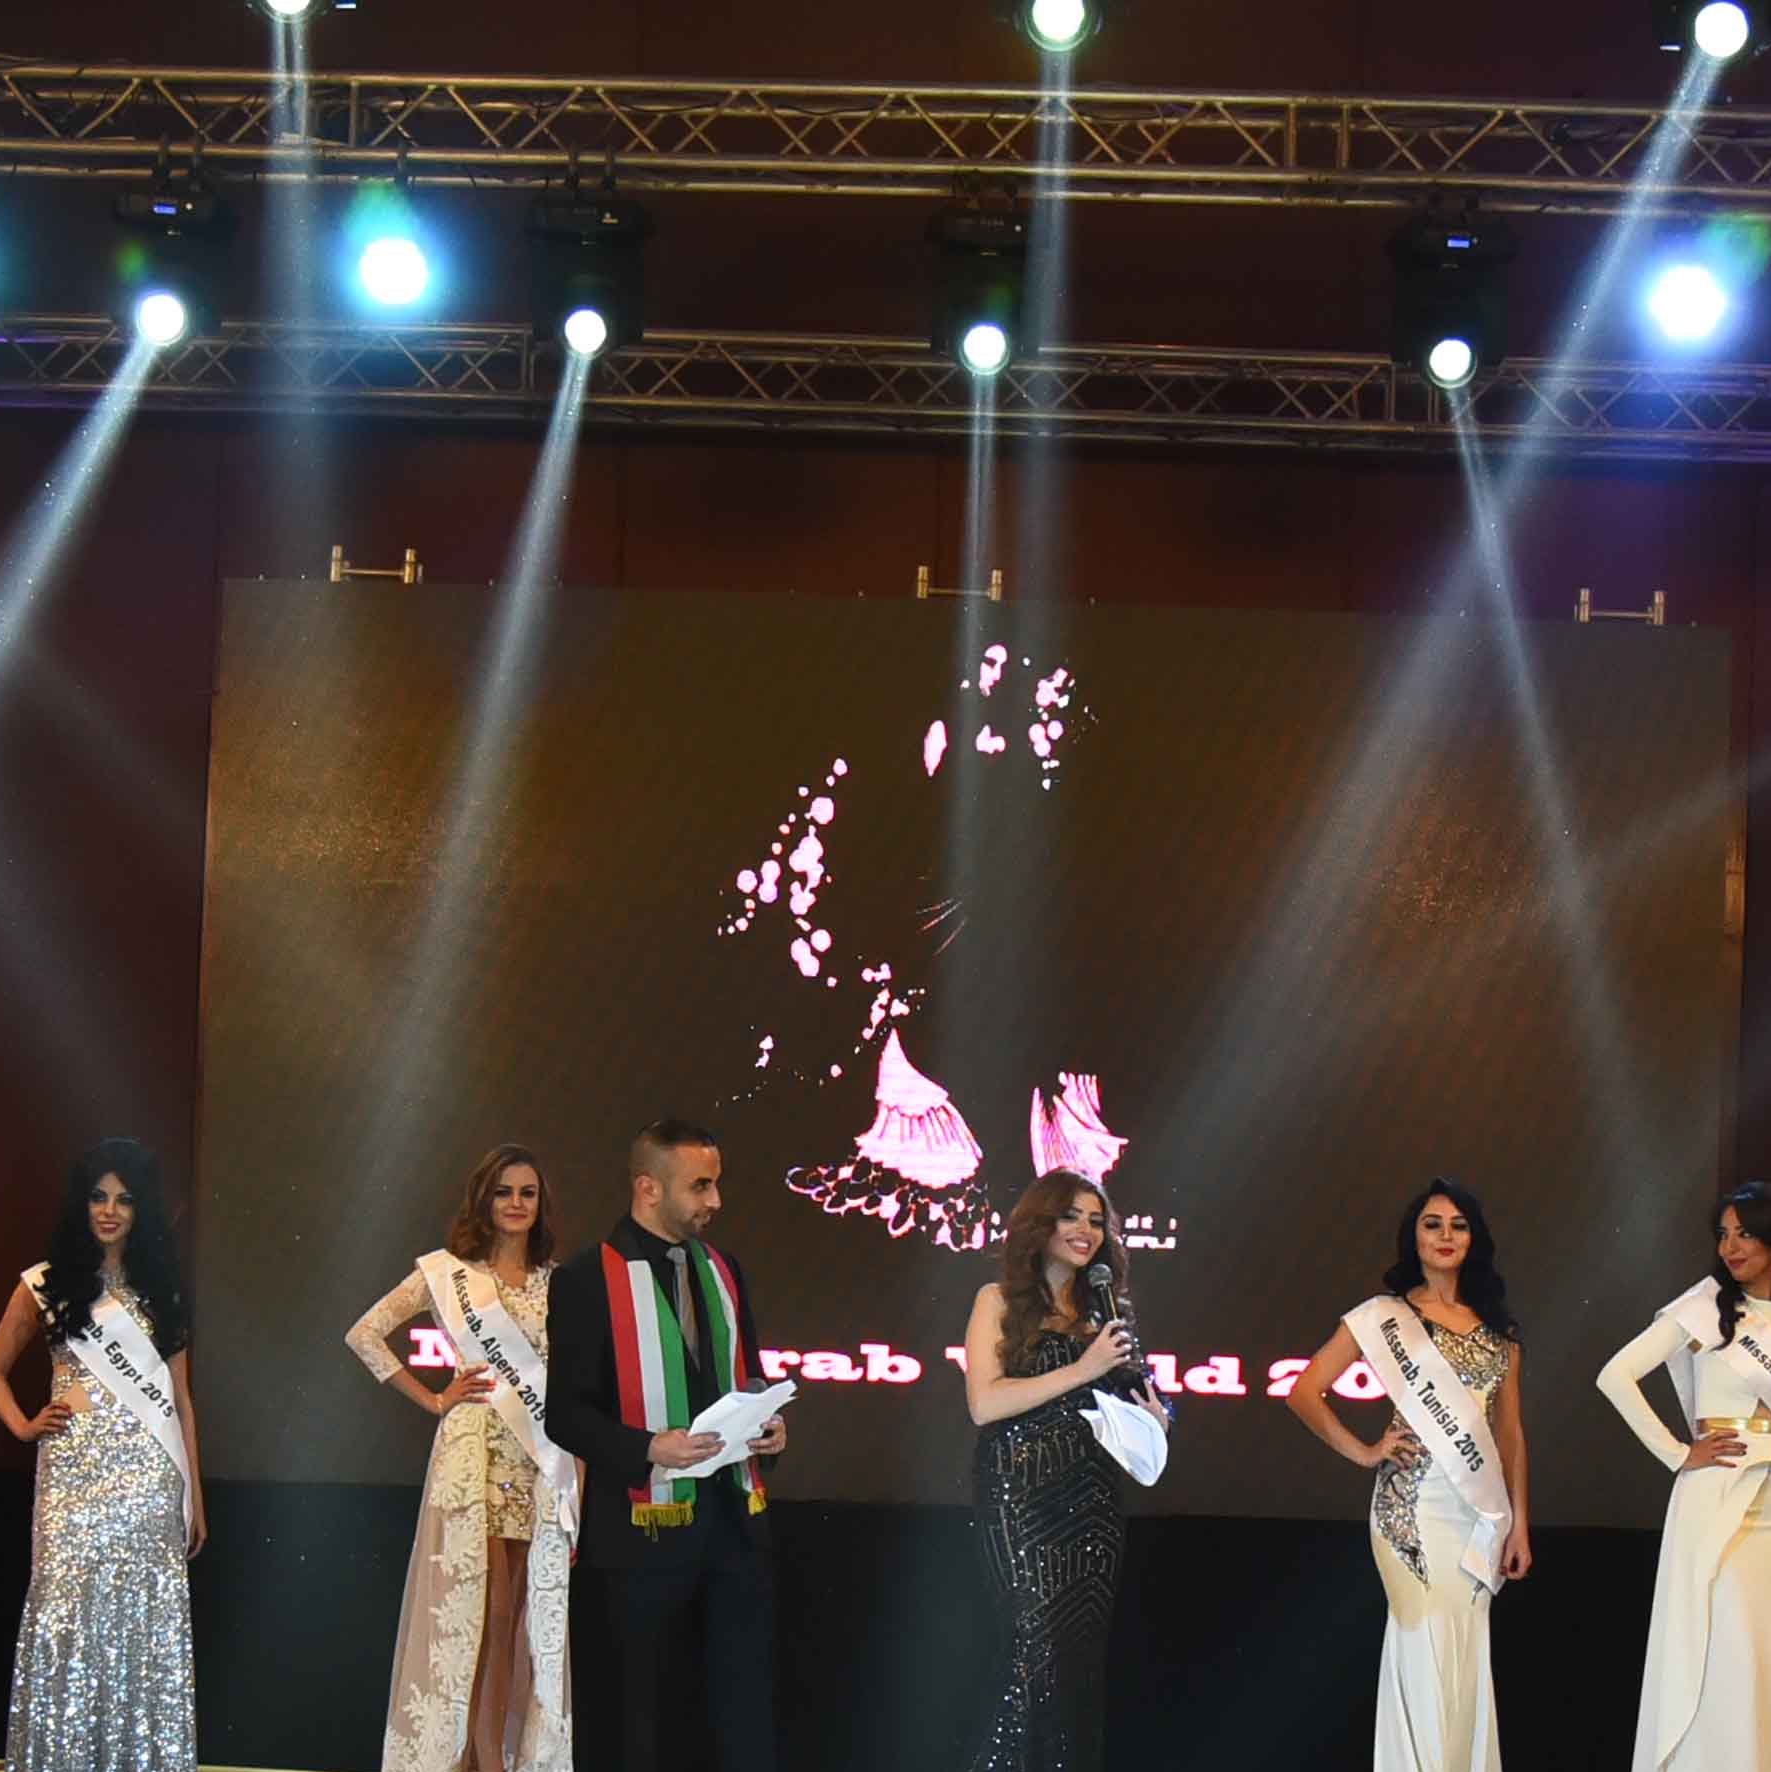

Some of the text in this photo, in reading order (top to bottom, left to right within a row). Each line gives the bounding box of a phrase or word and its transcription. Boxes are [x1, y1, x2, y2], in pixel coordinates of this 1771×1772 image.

[104, 1340, 174, 1418] Egypt 2015
[451, 1268, 546, 1423] Missarab. Algeria 2015
[756, 1343, 922, 1383] rab
[1380, 1317, 1485, 1473] Missarab. Tunisia 2015
